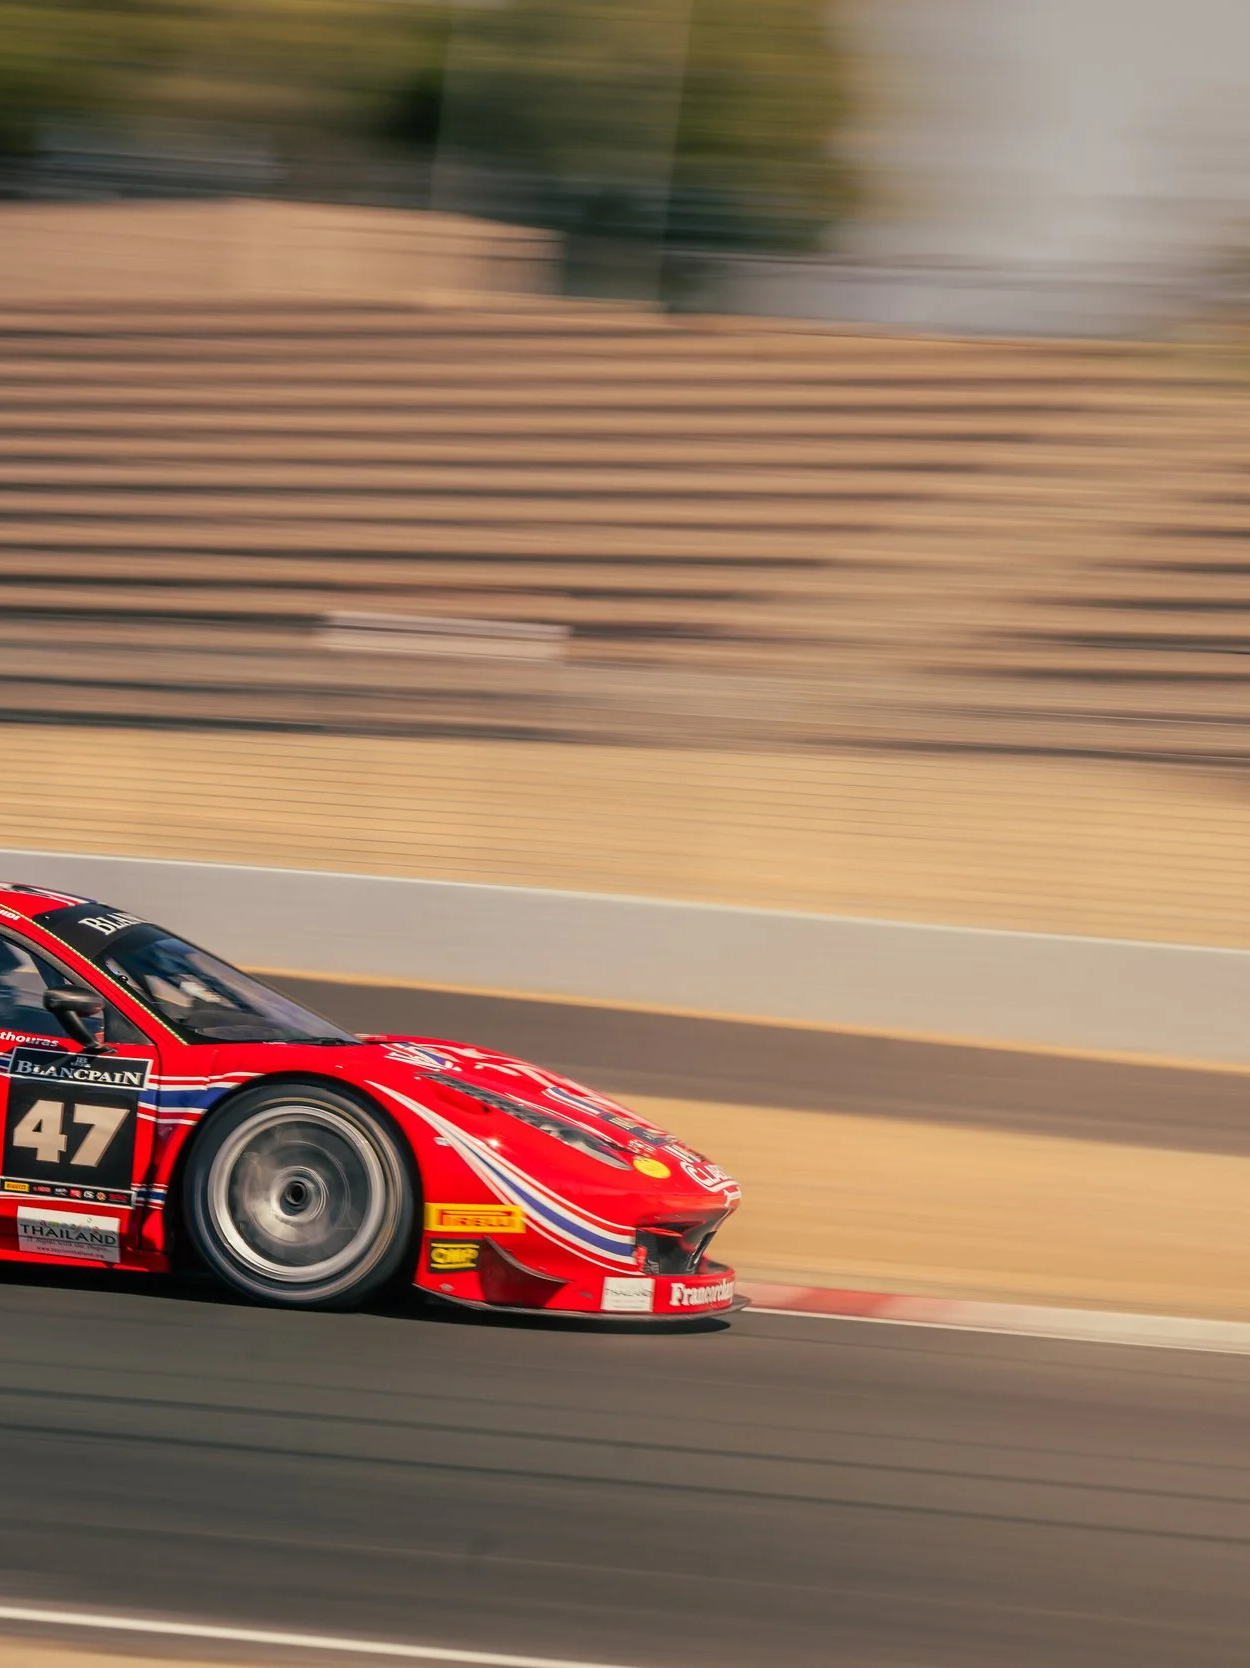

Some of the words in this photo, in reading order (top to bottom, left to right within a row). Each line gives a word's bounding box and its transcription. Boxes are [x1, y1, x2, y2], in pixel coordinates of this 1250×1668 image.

[16, 1060, 143, 1085] BLANCPAIN
[12, 1100, 130, 1167] 47
[20, 1224, 116, 1245] THAILAND
